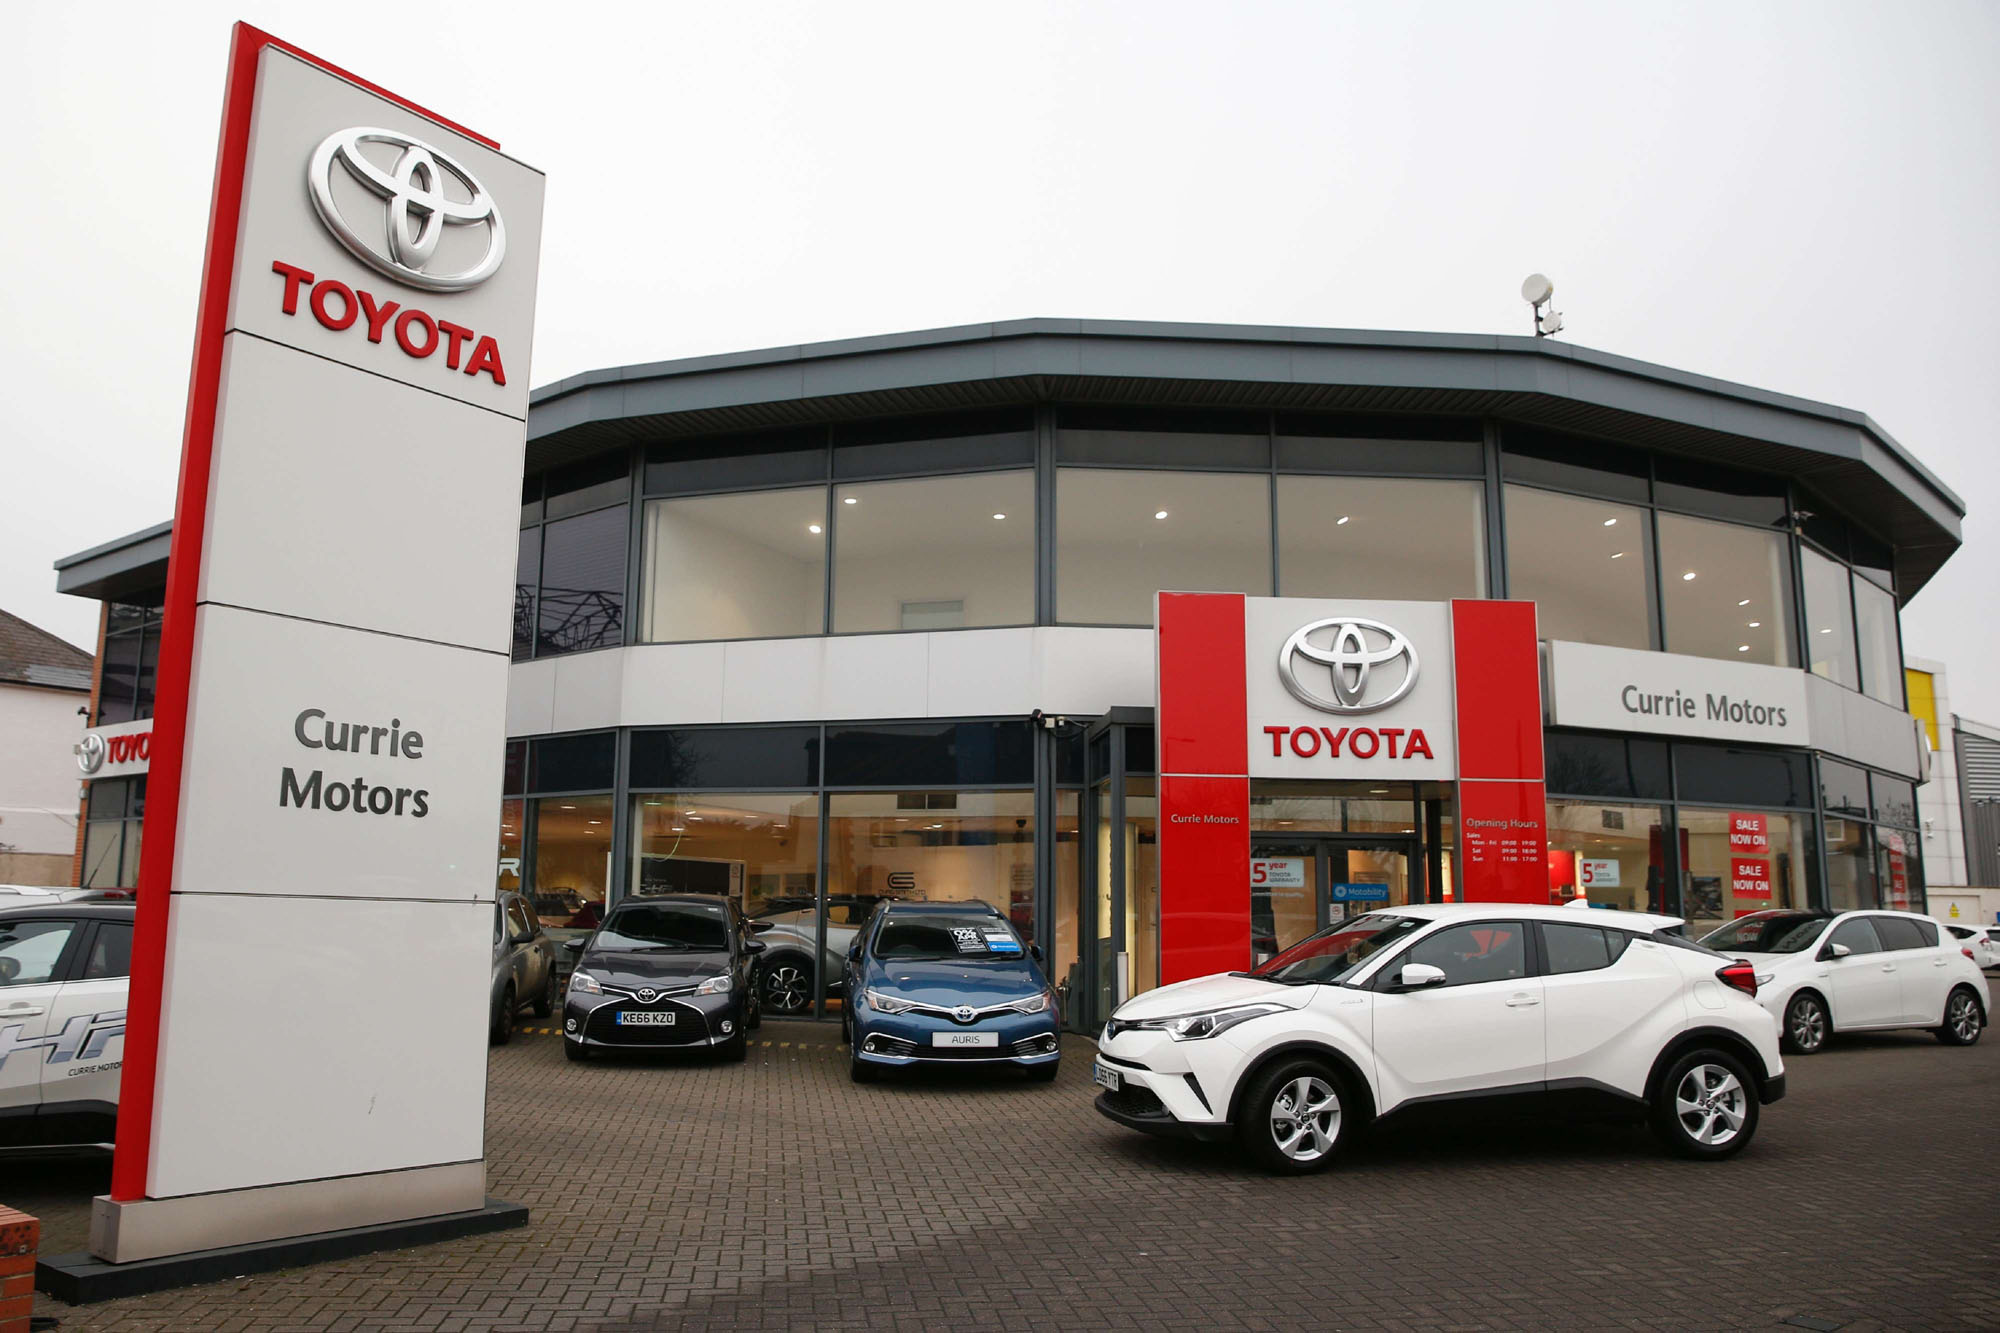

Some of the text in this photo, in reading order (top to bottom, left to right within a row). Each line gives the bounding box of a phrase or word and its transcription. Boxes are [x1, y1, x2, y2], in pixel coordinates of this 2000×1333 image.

[272, 260, 507, 387] TOYOTA
[1621, 684, 1788, 728] Currie Motors
[294, 708, 424, 760] Currie
[1263, 725, 1434, 760] TOYOTA
[279, 766, 430, 818] Motors
[1170, 813, 1240, 825] Currie Motors
[1466, 818, 1538, 829] Opening Hours
[1735, 819, 1760, 831] SALE
[1730, 833, 1767, 846] NOW ON
[1252, 862, 1267, 883] 5
[1268, 861, 1288, 871] year
[1583, 862, 1594, 883] 5
[1738, 865, 1763, 877] SALE
[1732, 879, 1769, 892] NOW ON
[622, 1013, 674, 1024] KE66 KZO
[951, 1035, 981, 1044] AURIS
[68, 1065, 97, 1076] CURRIE
